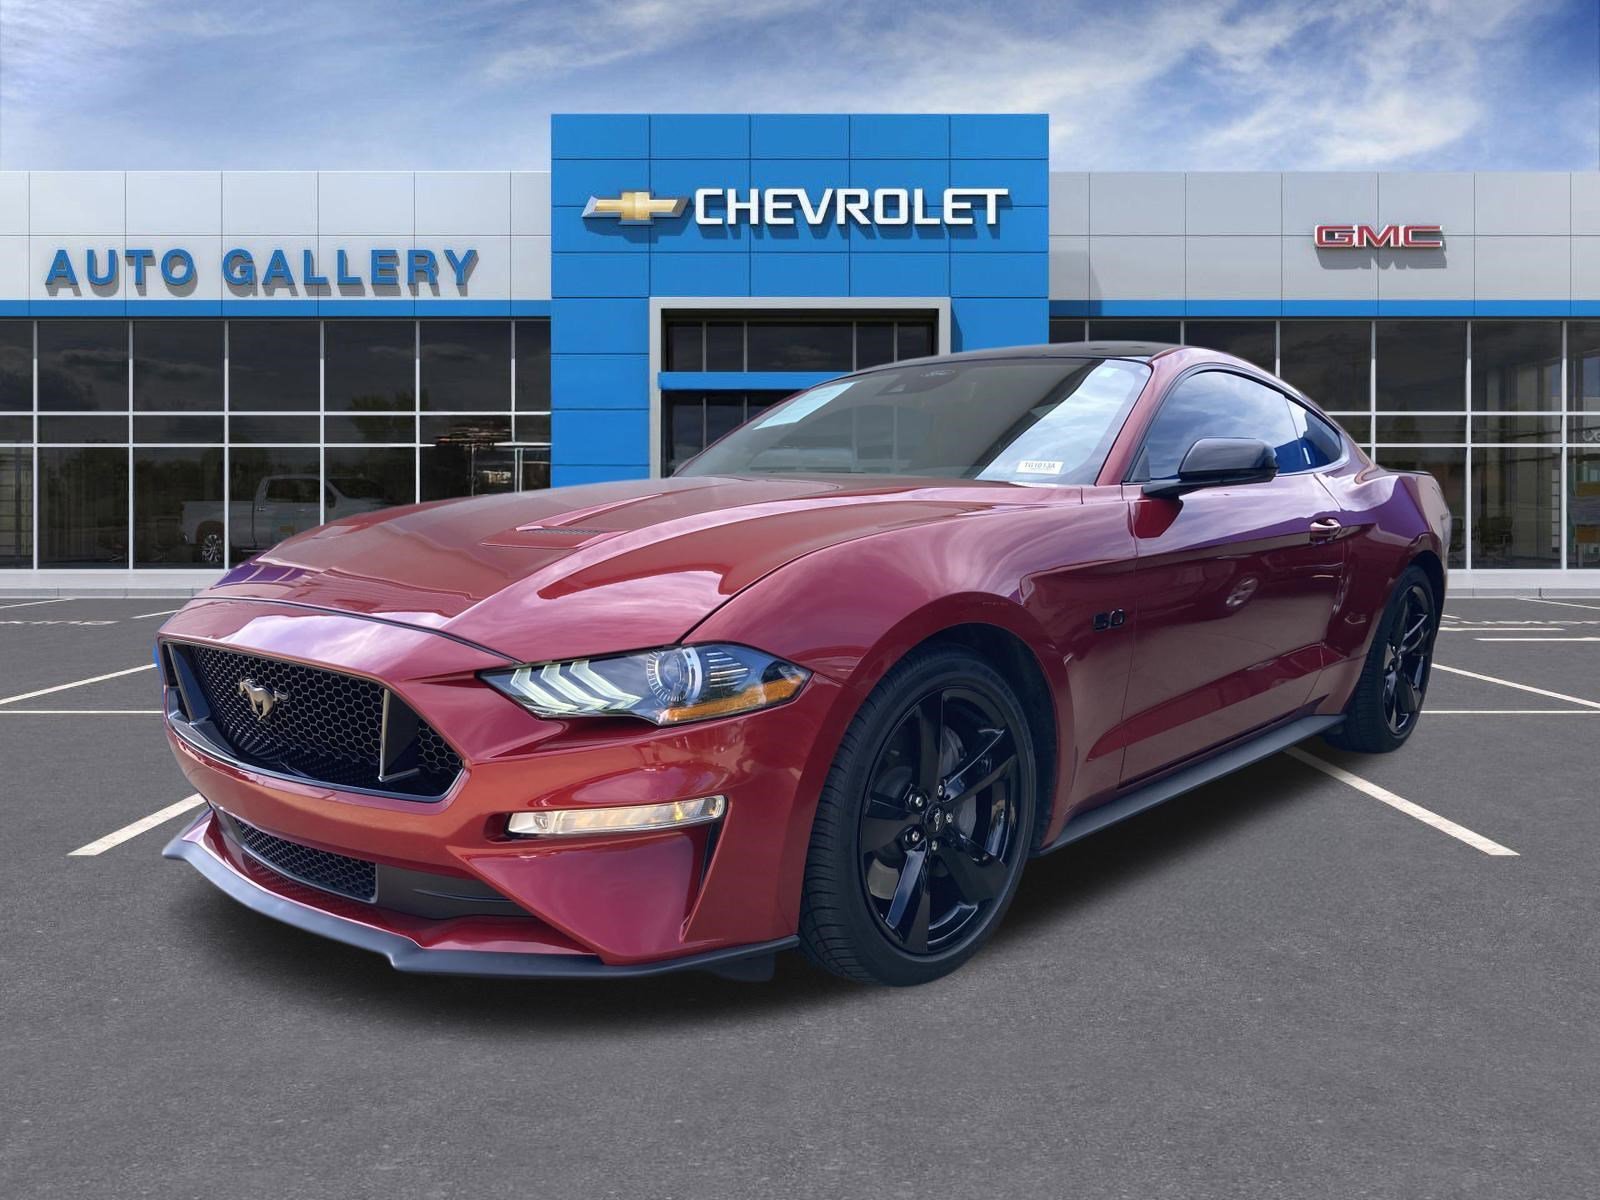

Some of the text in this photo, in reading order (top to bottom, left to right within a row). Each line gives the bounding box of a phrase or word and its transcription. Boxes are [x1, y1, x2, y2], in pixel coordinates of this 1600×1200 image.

[694, 188, 1009, 226] CHEVROLET
[1314, 224, 1443, 248] GMC
[45, 248, 477, 287] AUTO GALLERY
